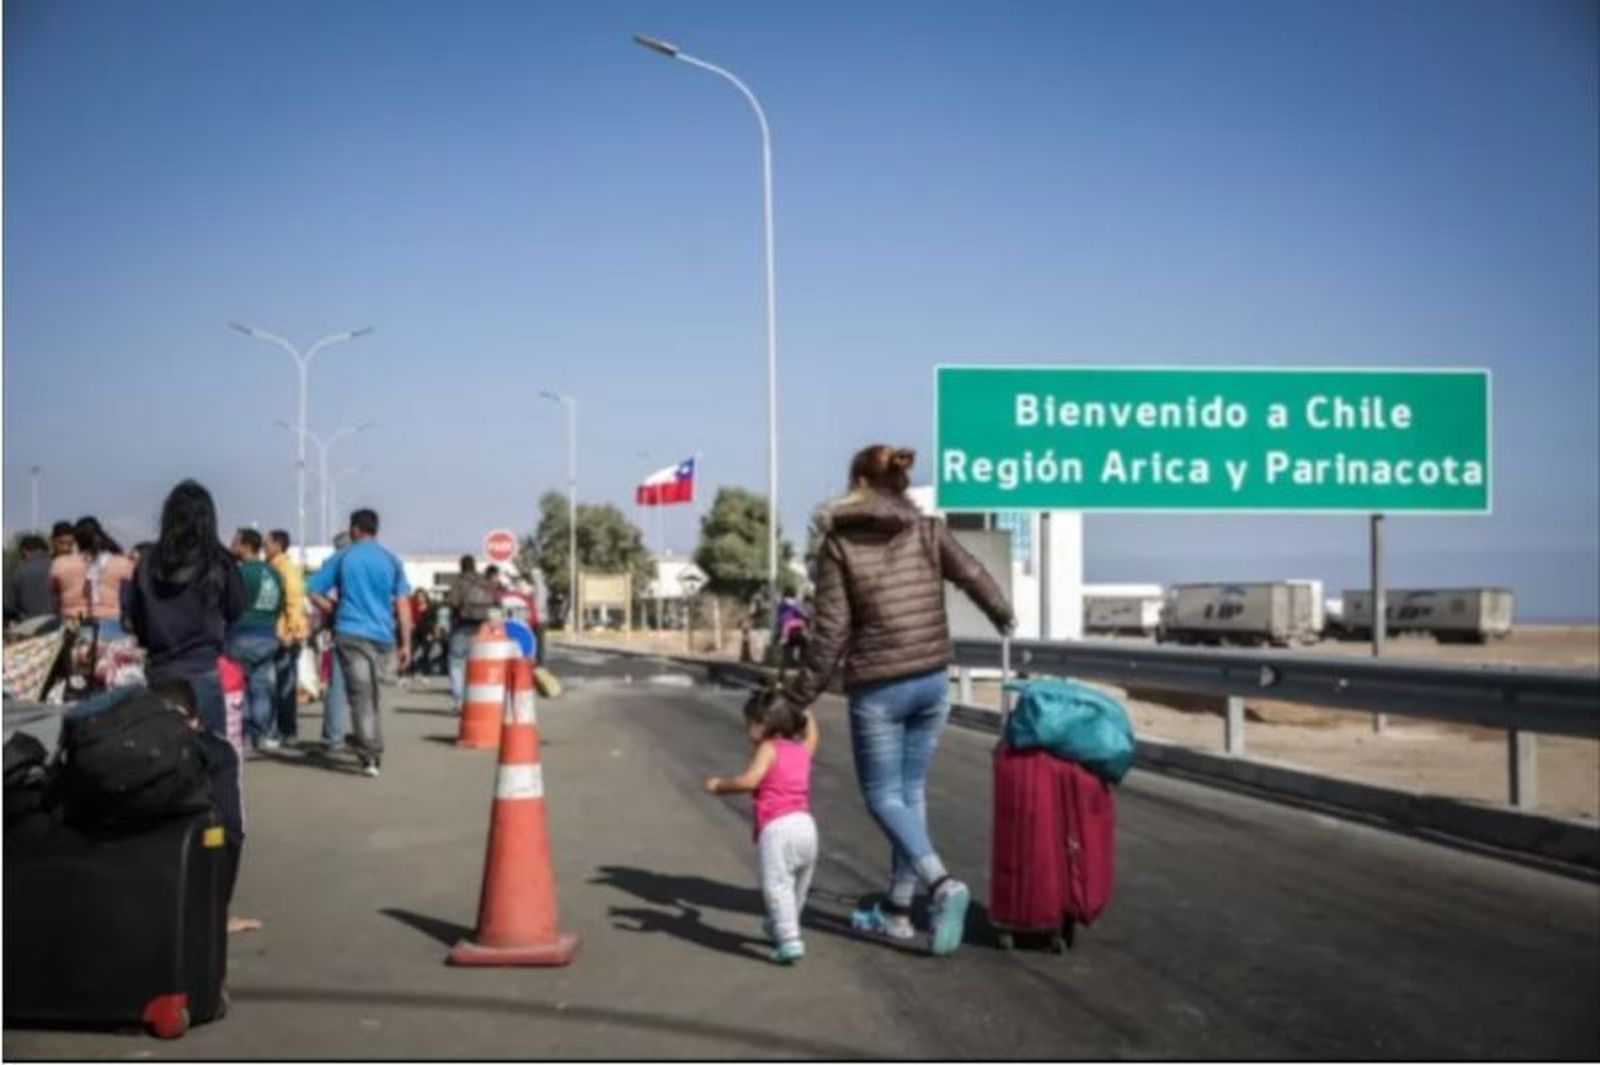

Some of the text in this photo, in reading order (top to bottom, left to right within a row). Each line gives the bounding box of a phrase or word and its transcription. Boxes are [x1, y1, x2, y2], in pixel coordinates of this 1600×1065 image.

[1014, 394, 1412, 430] Bienvenido a Chile
[942, 448, 1482, 491] Región Arica y Parinacota
